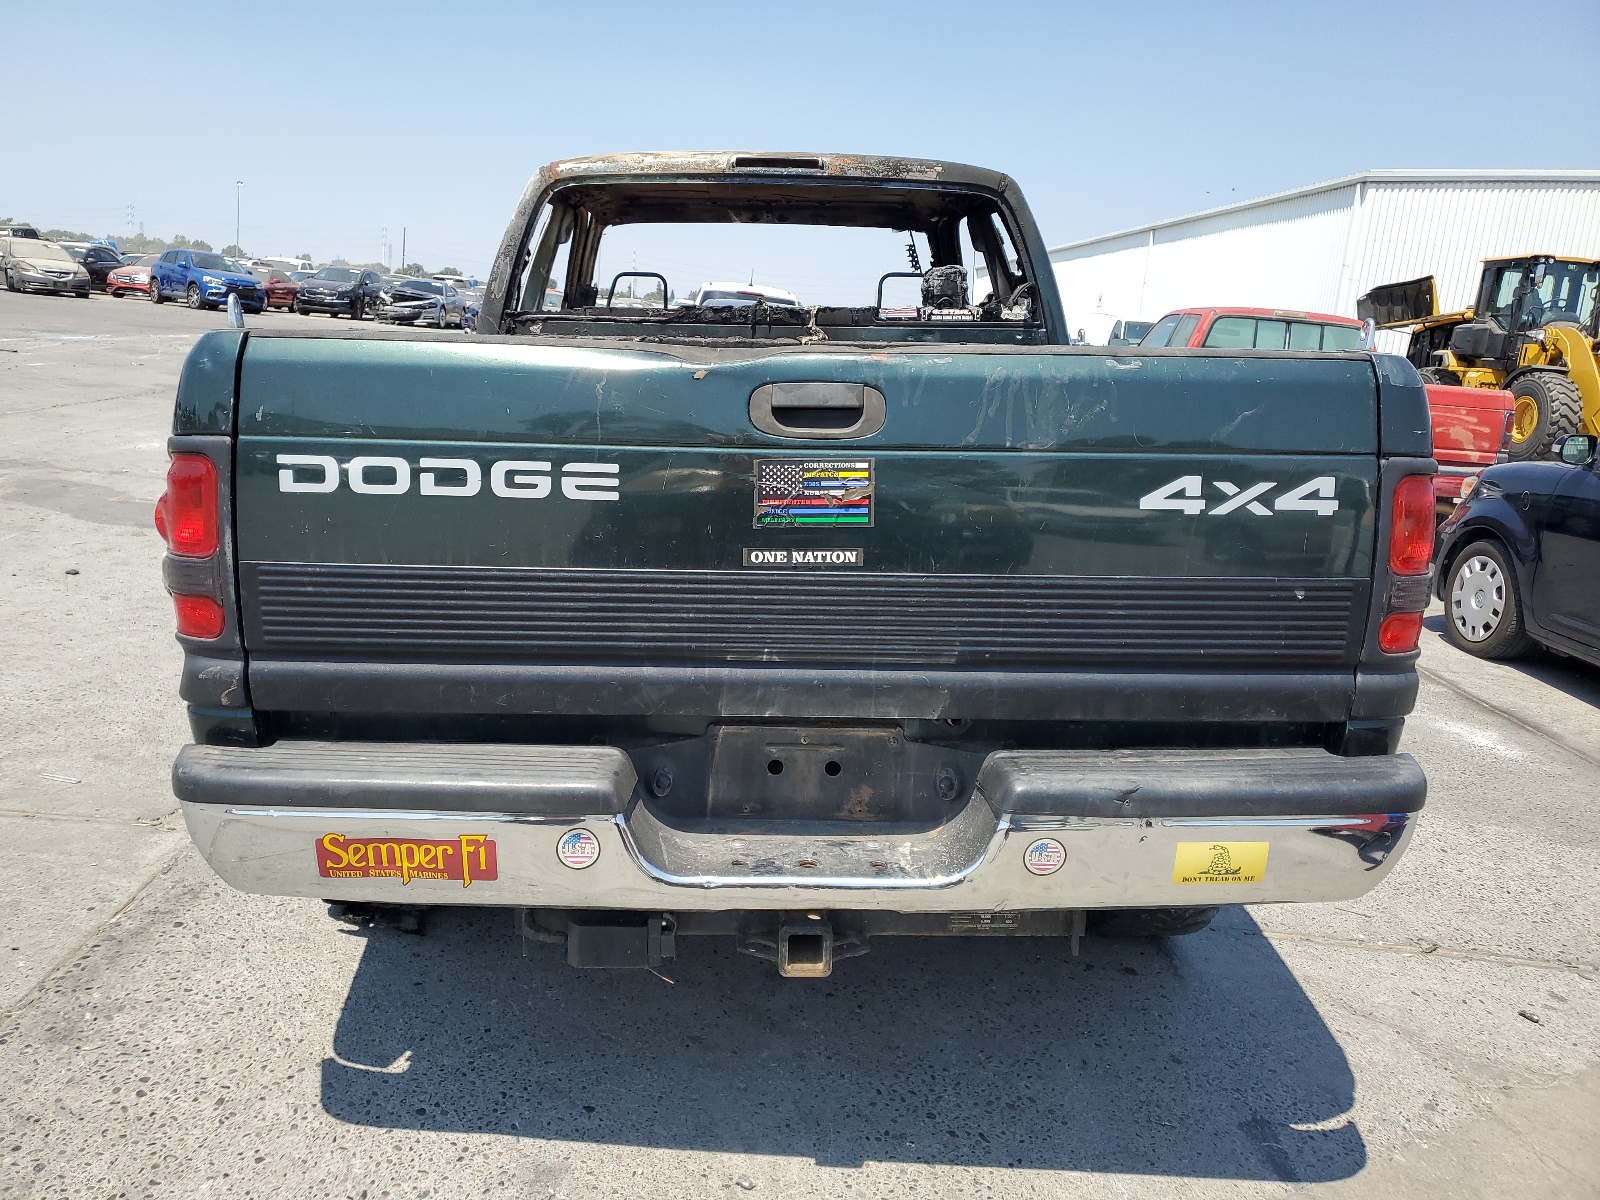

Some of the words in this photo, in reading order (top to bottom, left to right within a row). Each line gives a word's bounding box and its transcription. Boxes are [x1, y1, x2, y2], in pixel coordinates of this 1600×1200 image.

[276, 454, 620, 500] DODGE
[750, 551, 788, 564] ONE
[791, 551, 858, 564] NATION
[322, 832, 454, 886] Semper
[457, 834, 488, 888] Fi
[328, 869, 363, 878] UNITED
[368, 869, 402, 878] STATES
[409, 869, 449, 880] MARINES
